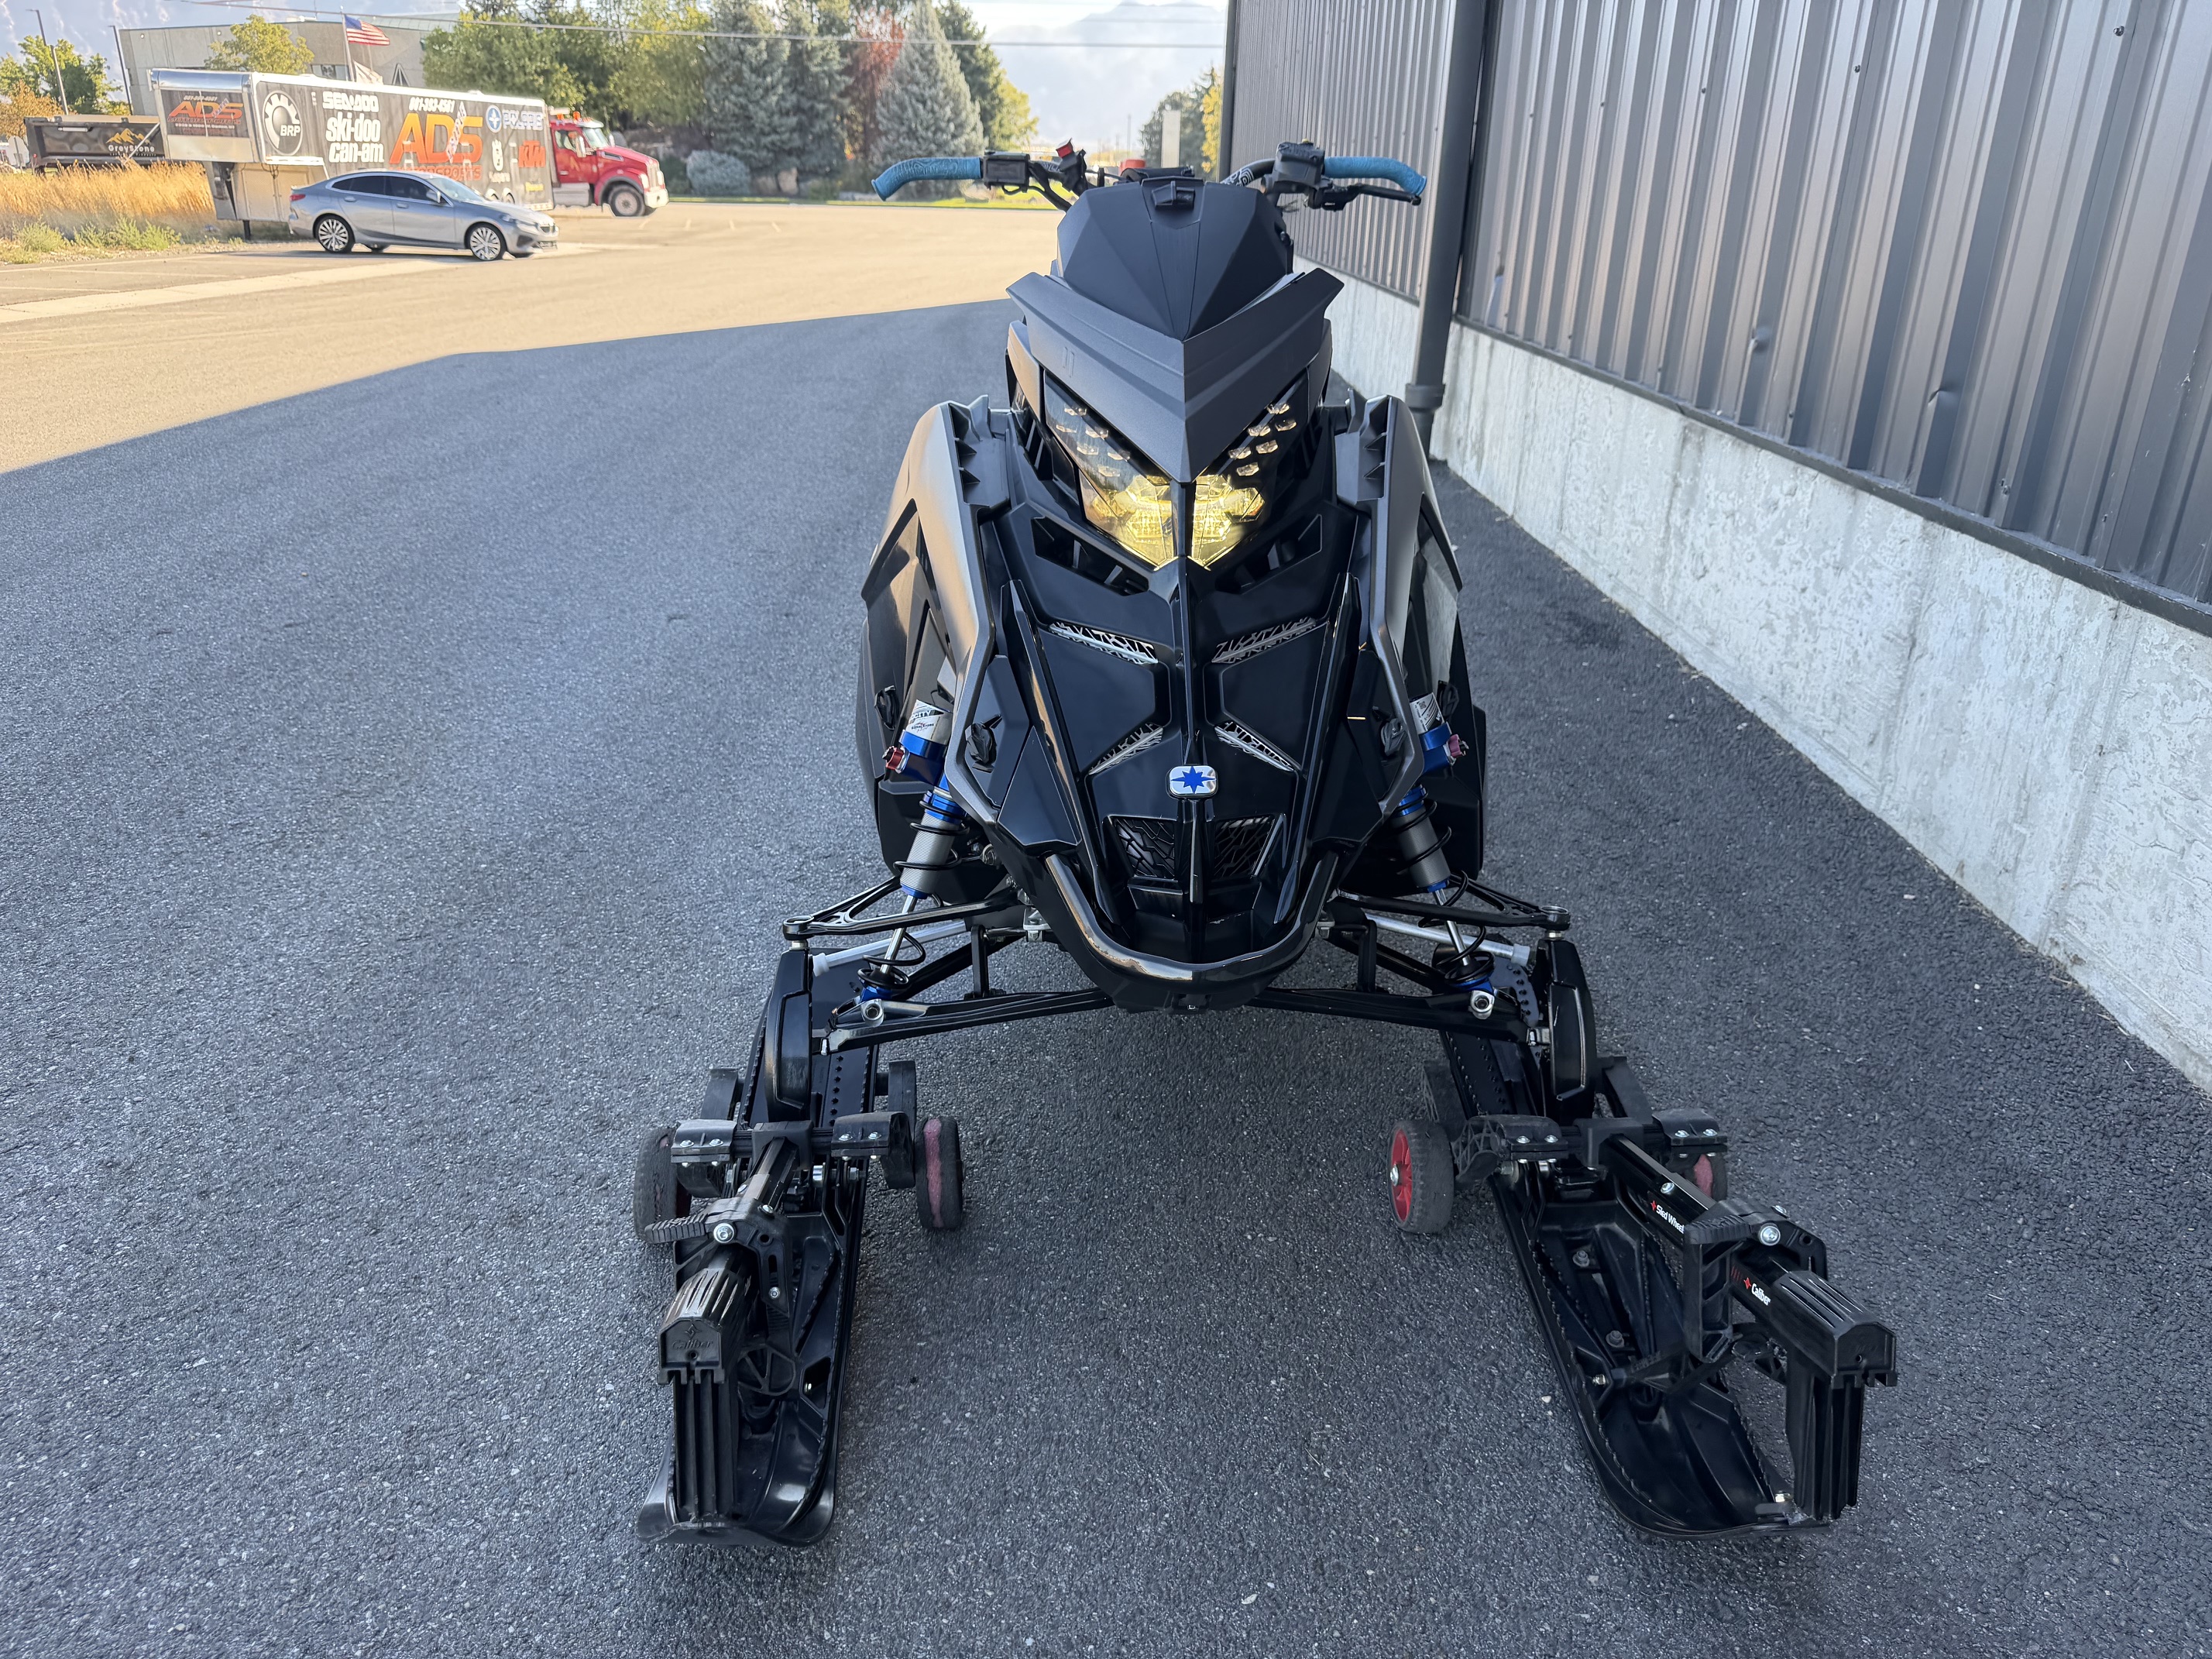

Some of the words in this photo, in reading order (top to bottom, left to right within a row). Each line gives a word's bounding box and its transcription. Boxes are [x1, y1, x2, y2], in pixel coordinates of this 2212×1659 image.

[168, 101, 244, 119] ADS
[502, 108, 544, 131] POLARIS
[280, 124, 301, 137] BRP
[389, 112, 483, 165] ADS
[108, 144, 155, 153] GreyStone
[518, 140, 546, 168] KTM
[1656, 1204, 1668, 1221] Sled
[1751, 1283, 1771, 1306] Caliber
[672, 1339, 714, 1350] Caliber
